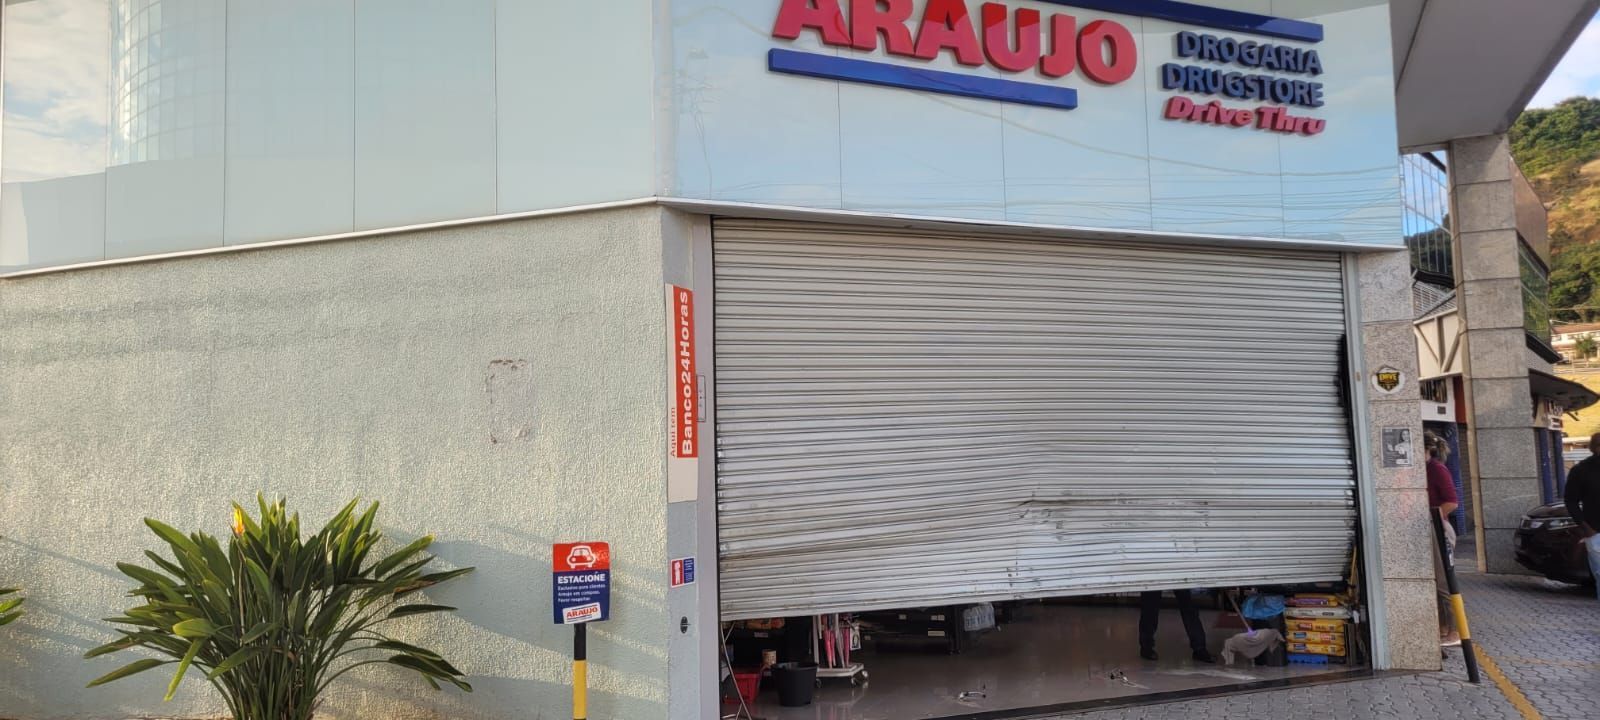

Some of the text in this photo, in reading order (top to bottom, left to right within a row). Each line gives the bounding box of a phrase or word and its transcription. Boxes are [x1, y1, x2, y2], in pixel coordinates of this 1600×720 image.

[772, 0, 1138, 85] ARAUJO
[1177, 30, 1324, 75] DROGARIA
[1162, 62, 1325, 107] DRUGSTORE
[1164, 96, 1326, 135] Drive Thru
[680, 291, 693, 455] Banco24Horas
[567, 607, 598, 617] ARAUJO
